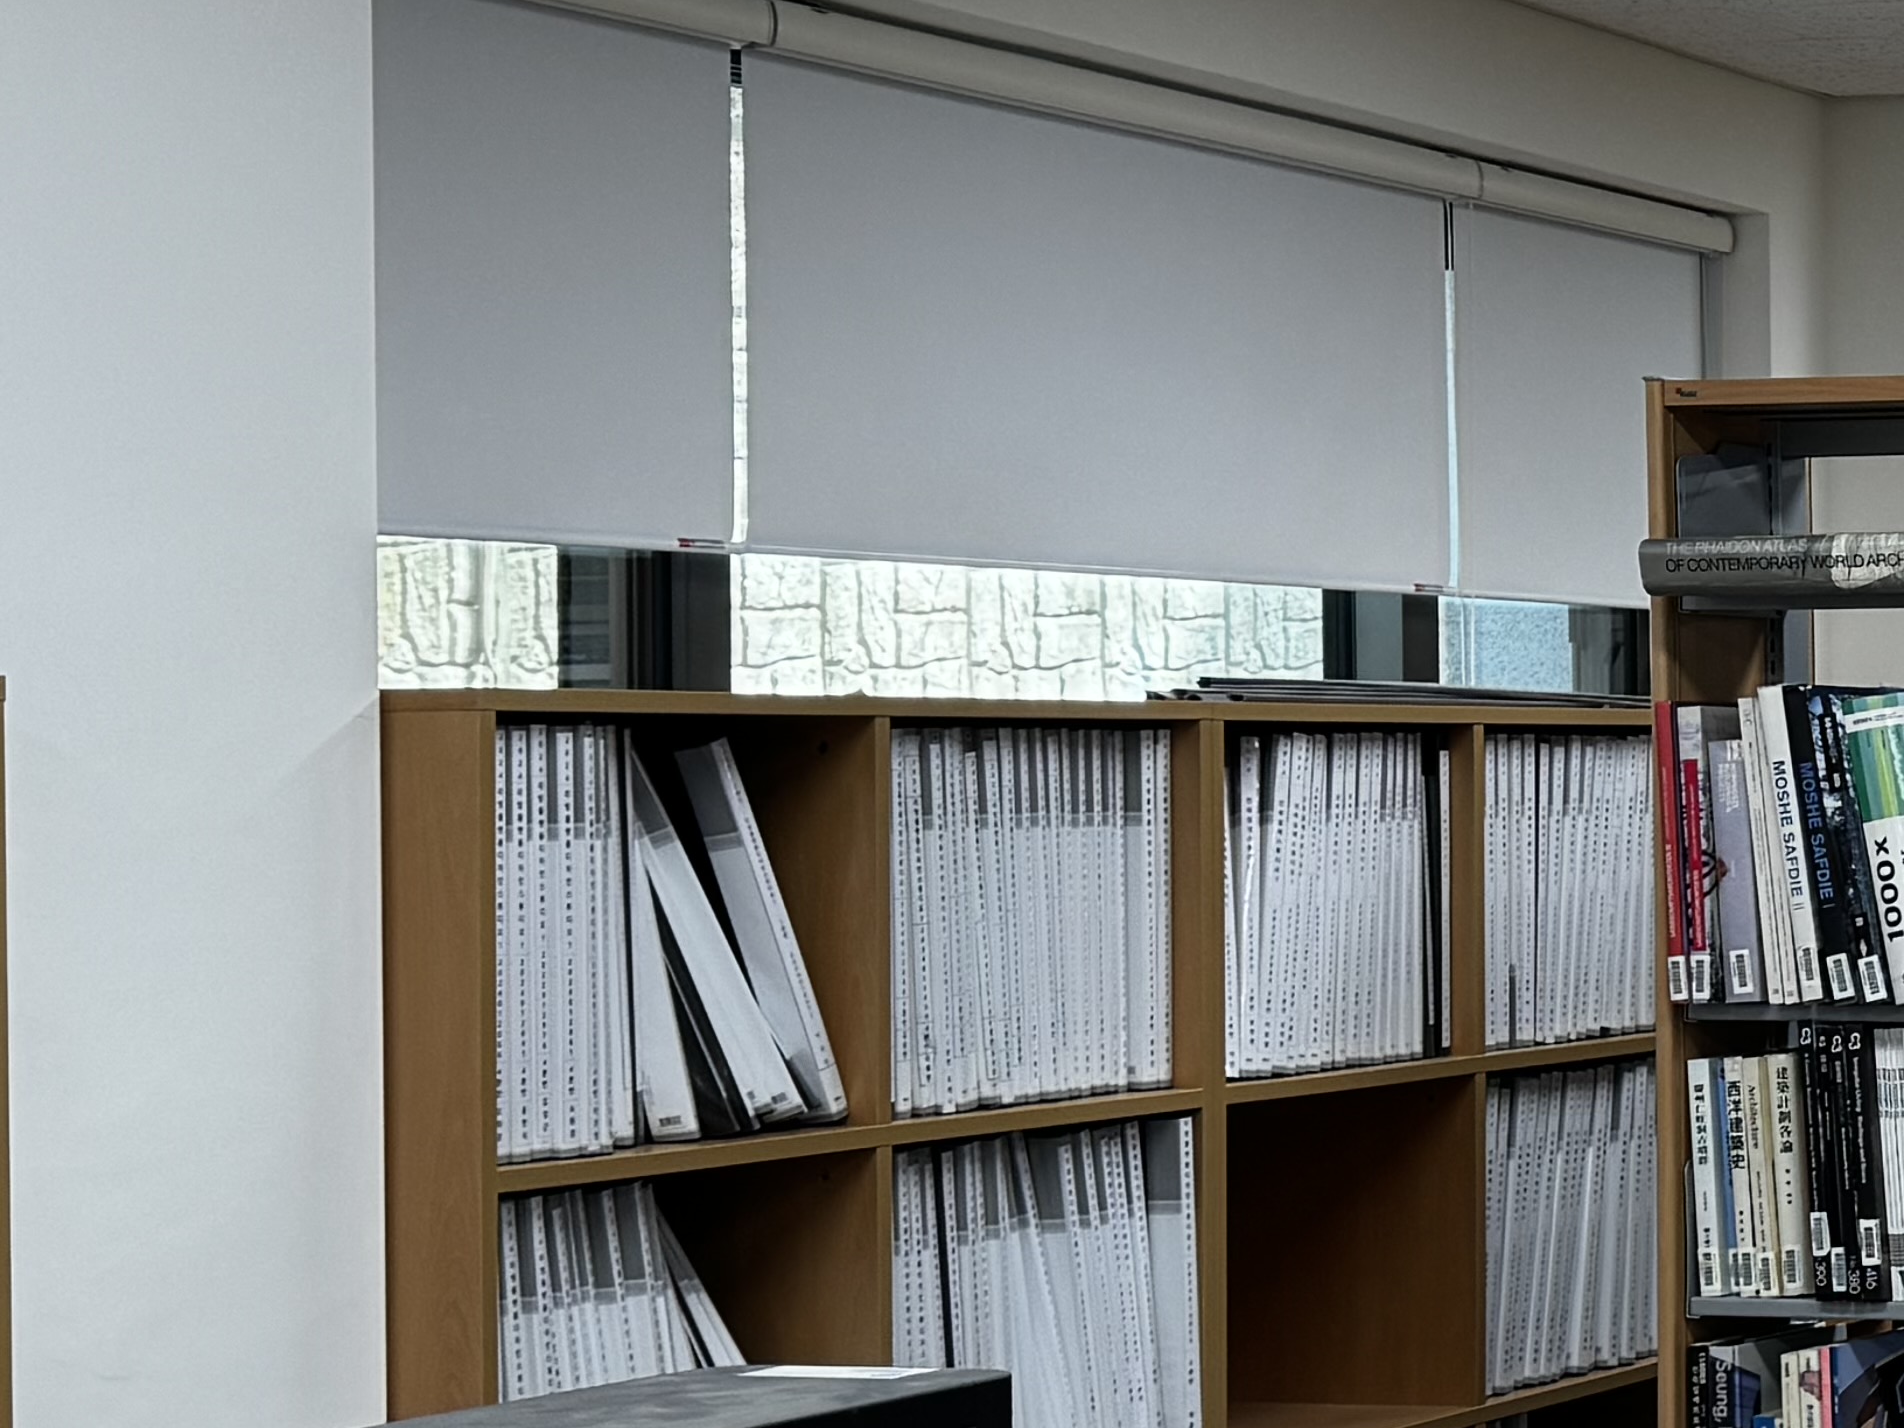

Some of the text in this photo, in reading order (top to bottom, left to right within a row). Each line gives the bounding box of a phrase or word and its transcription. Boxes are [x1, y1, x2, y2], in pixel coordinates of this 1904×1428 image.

[1665, 557, 1685, 572] OF
[1687, 555, 1808, 573] CONTEMPORARY
[1810, 553, 1865, 571] WORLD
[1772, 760, 1794, 827] MOSHE
[1783, 829, 1804, 897] SAFDIE
[1799, 762, 1822, 829] MOSHE
[1811, 832, 1834, 900] SAFDIE
[1712, 1360, 1732, 1422] Seung,
